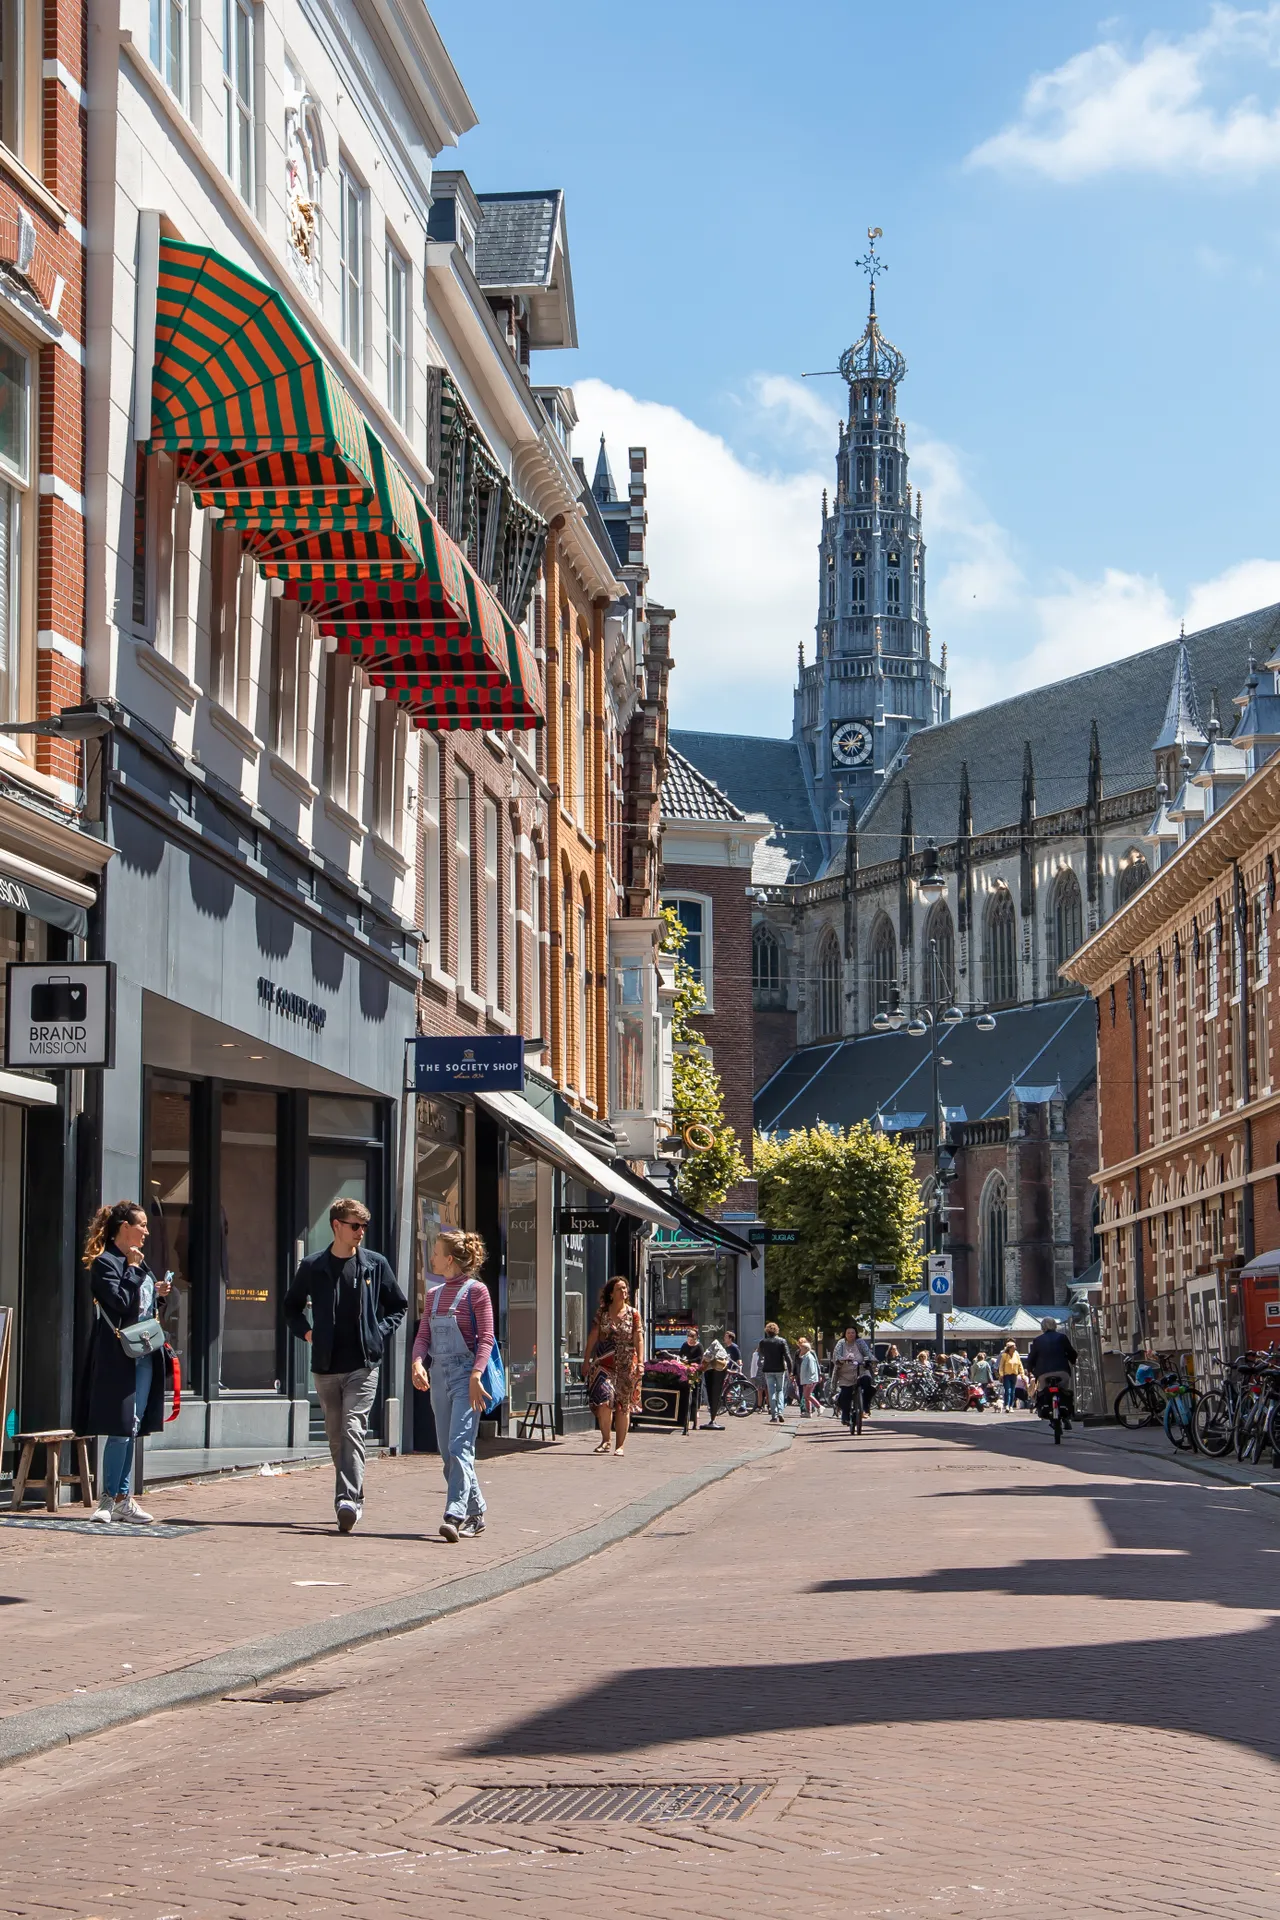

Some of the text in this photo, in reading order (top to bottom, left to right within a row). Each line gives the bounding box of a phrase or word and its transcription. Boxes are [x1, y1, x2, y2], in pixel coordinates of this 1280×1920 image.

[257, 976, 327, 1028] THE SOCIETY SHOP
[29, 1026, 87, 1041] BRAND
[29, 1042, 87, 1054] MISSION
[419, 1062, 519, 1072] THE SOCIETY SHOP
[571, 1216, 600, 1232] kpa.
[246, 1289, 269, 1297] PRE-SALE
